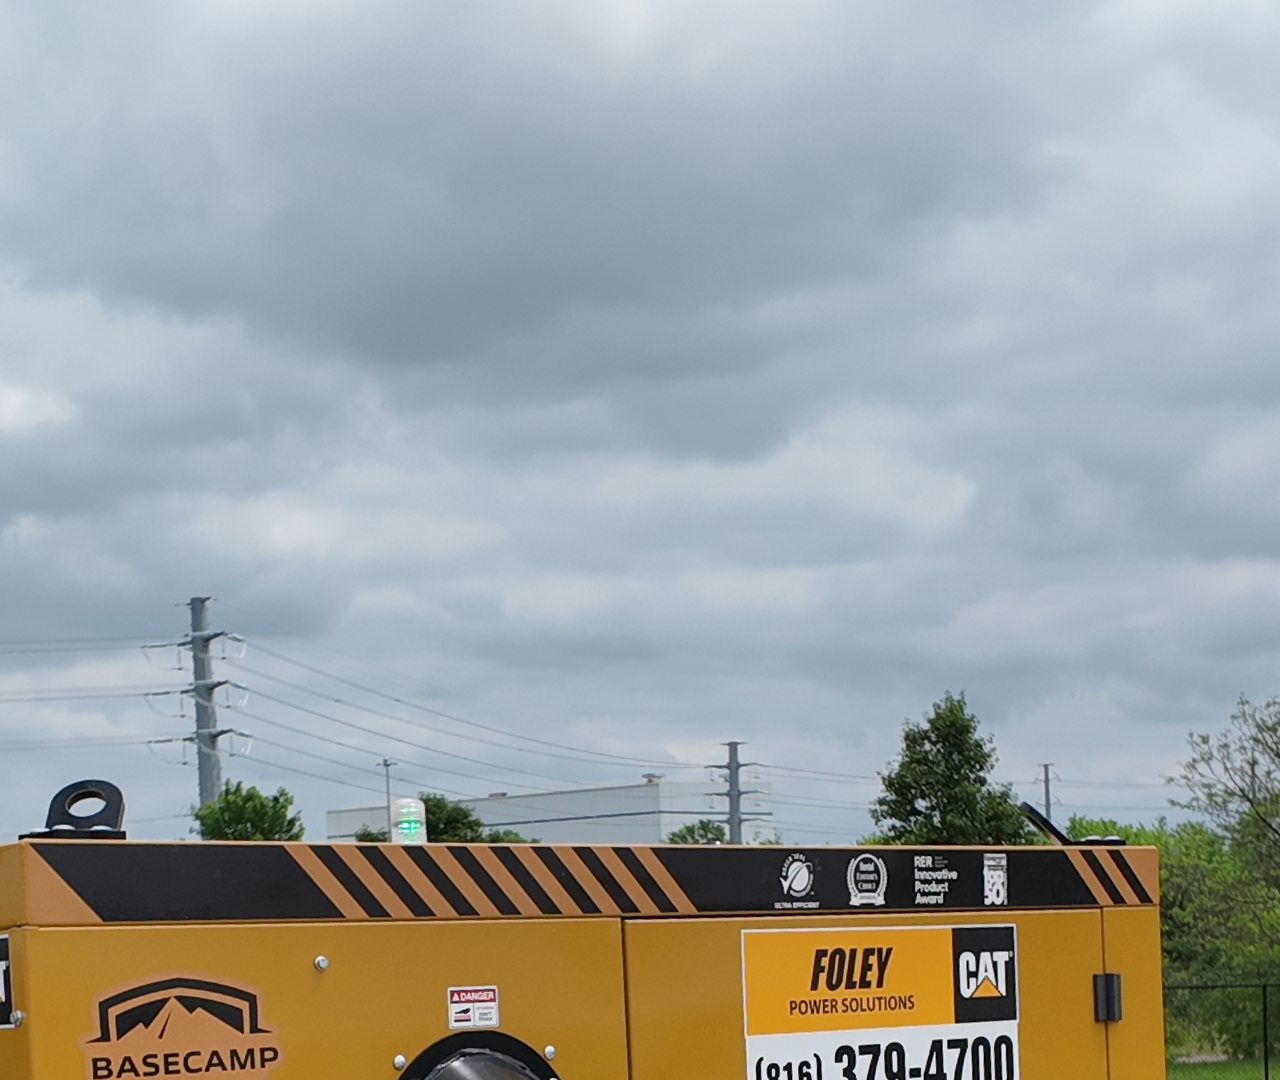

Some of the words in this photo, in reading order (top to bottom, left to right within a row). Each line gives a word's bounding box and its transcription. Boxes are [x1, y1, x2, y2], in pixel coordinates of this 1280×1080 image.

[914, 868, 958, 880] Innovative
[914, 881, 949, 892] Product
[914, 892, 944, 905] Award
[810, 947, 893, 992] FOLEY
[959, 950, 1010, 999] CAT
[460, 991, 494, 1001] DANGER
[789, 998, 839, 1016] POWER
[841, 994, 916, 1014] SOLUTIONS
[91, 1046, 279, 1080] BASECAMP
